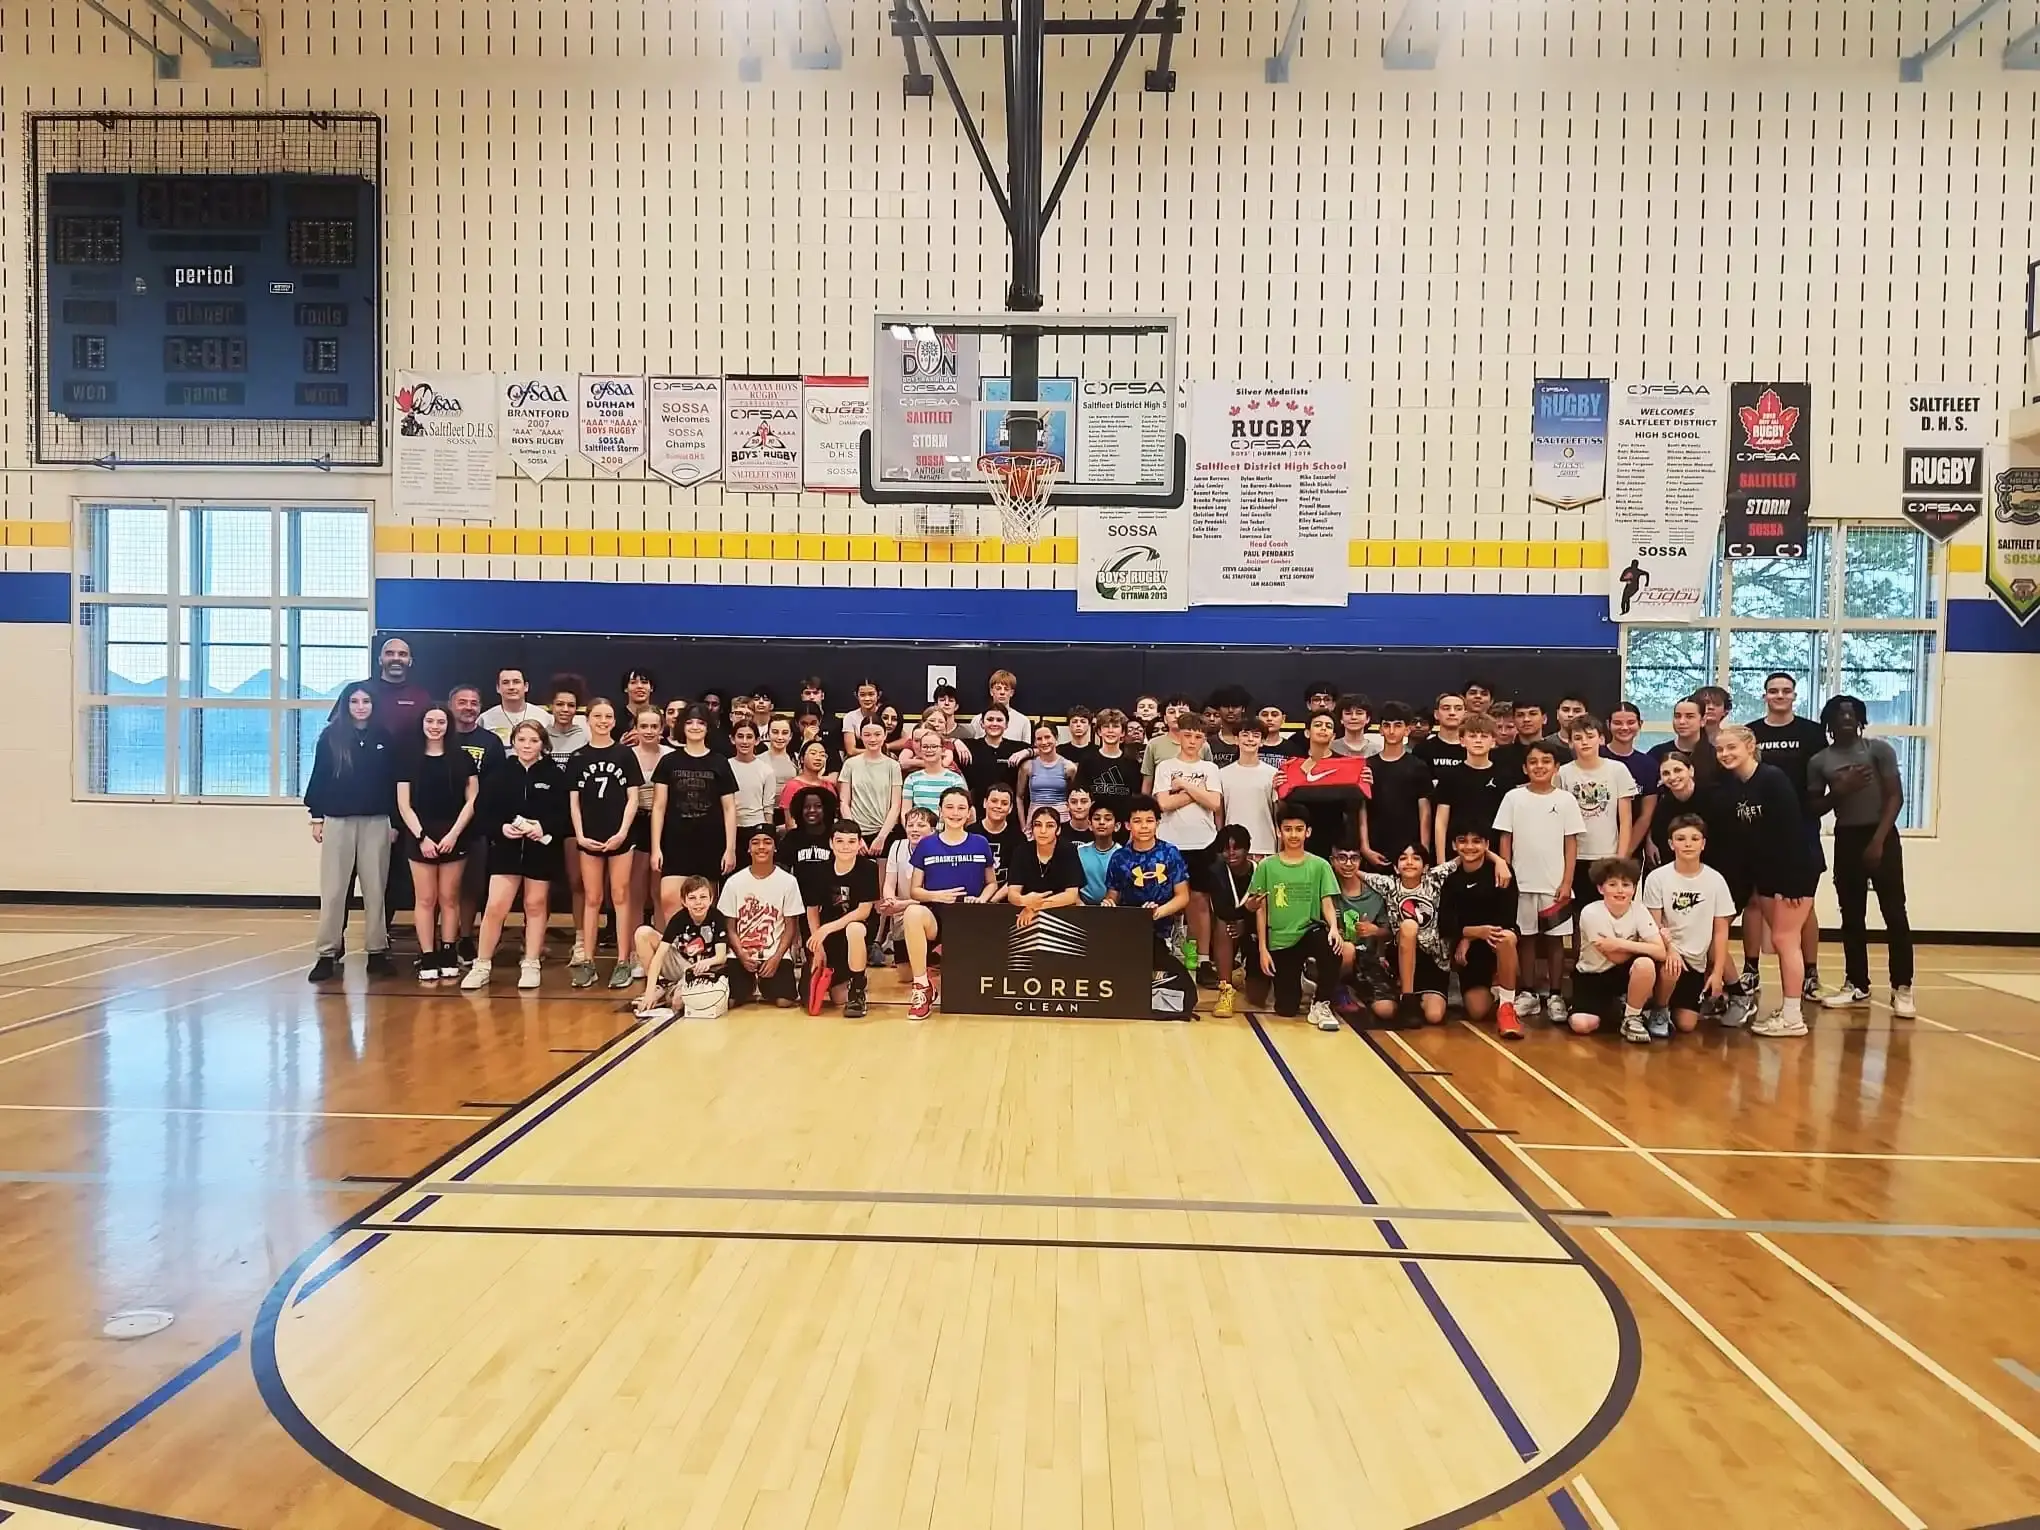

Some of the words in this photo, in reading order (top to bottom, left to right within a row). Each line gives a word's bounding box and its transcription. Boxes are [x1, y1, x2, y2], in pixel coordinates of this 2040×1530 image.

[175, 265, 233, 287] period
[653, 382, 717, 391] OFSAA
[1236, 388, 1262, 396] Silver
[1265, 388, 1308, 396] Medalists
[1627, 384, 1710, 395] OFSAA
[587, 401, 635, 409] DURHAM
[662, 403, 709, 413] SOSSA
[1083, 401, 1113, 409] Saltfleet
[1115, 401, 1142, 409] District
[1144, 401, 1161, 411] High
[1541, 393, 1601, 419] RUGBY
[1909, 397, 1980, 412] SALTFLEET
[507, 409, 569, 418] BRANTFORD
[600, 409, 624, 417] 2008
[731, 409, 798, 419] OFSAA
[907, 411, 953, 424] SALTFLEET
[1640, 408, 1695, 416] WELCOMES
[528, 420, 550, 428] 2007
[661, 415, 710, 423] Welcomes
[429, 422, 464, 437] Saltfleet
[467, 422, 496, 438] D.H.S.
[668, 429, 703, 437] SOSSA
[1232, 420, 1311, 437] RUGBY
[1753, 425, 1785, 438] RUGBY
[512, 437, 534, 445] BOYS
[536, 437, 564, 445] RUGBY
[665, 440, 706, 449] Champs
[912, 434, 948, 448] STORM
[1231, 440, 1311, 450] OFSAA
[585, 444, 615, 452] Saltfleet
[732, 451, 760, 462] BOYS'
[764, 451, 798, 462] RUGBY
[916, 455, 945, 466] SOSSA
[1737, 453, 1800, 461] OFSAA
[915, 466, 945, 475] ANTIQUE
[1195, 462, 1240, 471] Saltfleet
[1244, 462, 1281, 470] District
[1284, 462, 1309, 472] High
[1313, 461, 1347, 470] School
[1910, 457, 1976, 485] RUGBY
[732, 471, 769, 479] SALTFLEET
[771, 471, 796, 479] STORM
[1740, 473, 1797, 488] SALTFLEET
[1746, 499, 1791, 515] STORM
[1908, 503, 1976, 513] OFSAA
[1108, 525, 1157, 537] SOSSA
[1748, 523, 1784, 537] SOSSA
[1250, 540, 1267, 548] Head
[1269, 540, 1288, 548] Coach
[1998, 539, 2034, 550] SALTFLEET
[1638, 546, 1687, 557] SOSSA
[1130, 571, 1168, 584] RUGBY
[1121, 592, 1149, 600] OTTAWA
[1151, 592, 1168, 600] 2013
[1636, 590, 1700, 604] rugby
[1433, 758, 1462, 766] VUKO
[578, 761, 627, 788] RAPTORS
[595, 776, 608, 798] 7
[798, 847, 813, 862] NEW
[813, 846, 831, 861] YORK
[934, 854, 973, 864] BASKETBALL
[980, 976, 1114, 998] FLORES
[1014, 1001, 1080, 1013] CLEAN
